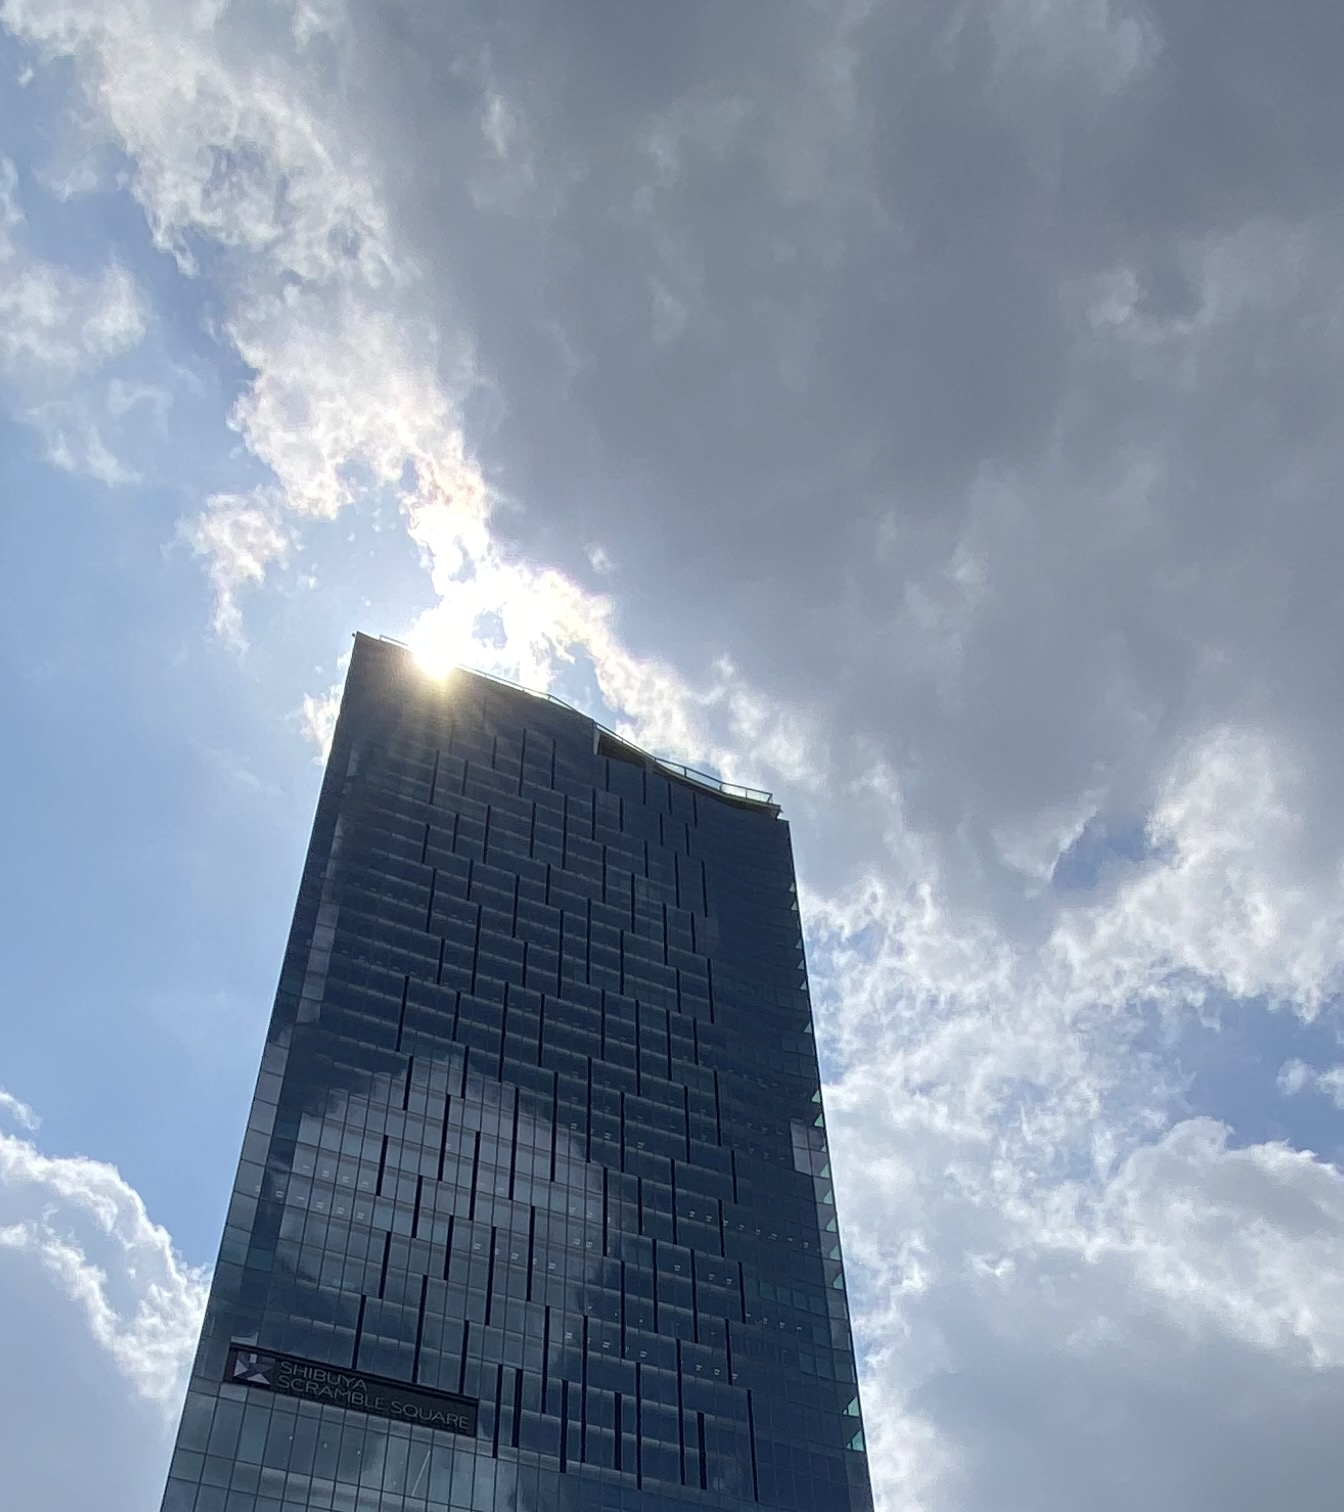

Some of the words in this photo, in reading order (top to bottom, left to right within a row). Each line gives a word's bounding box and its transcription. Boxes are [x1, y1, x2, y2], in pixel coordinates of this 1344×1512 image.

[279, 1361, 368, 1391] SHIBUYA
[276, 1375, 386, 1412] SCRAMBLE
[390, 1400, 470, 1430] SQUARE
